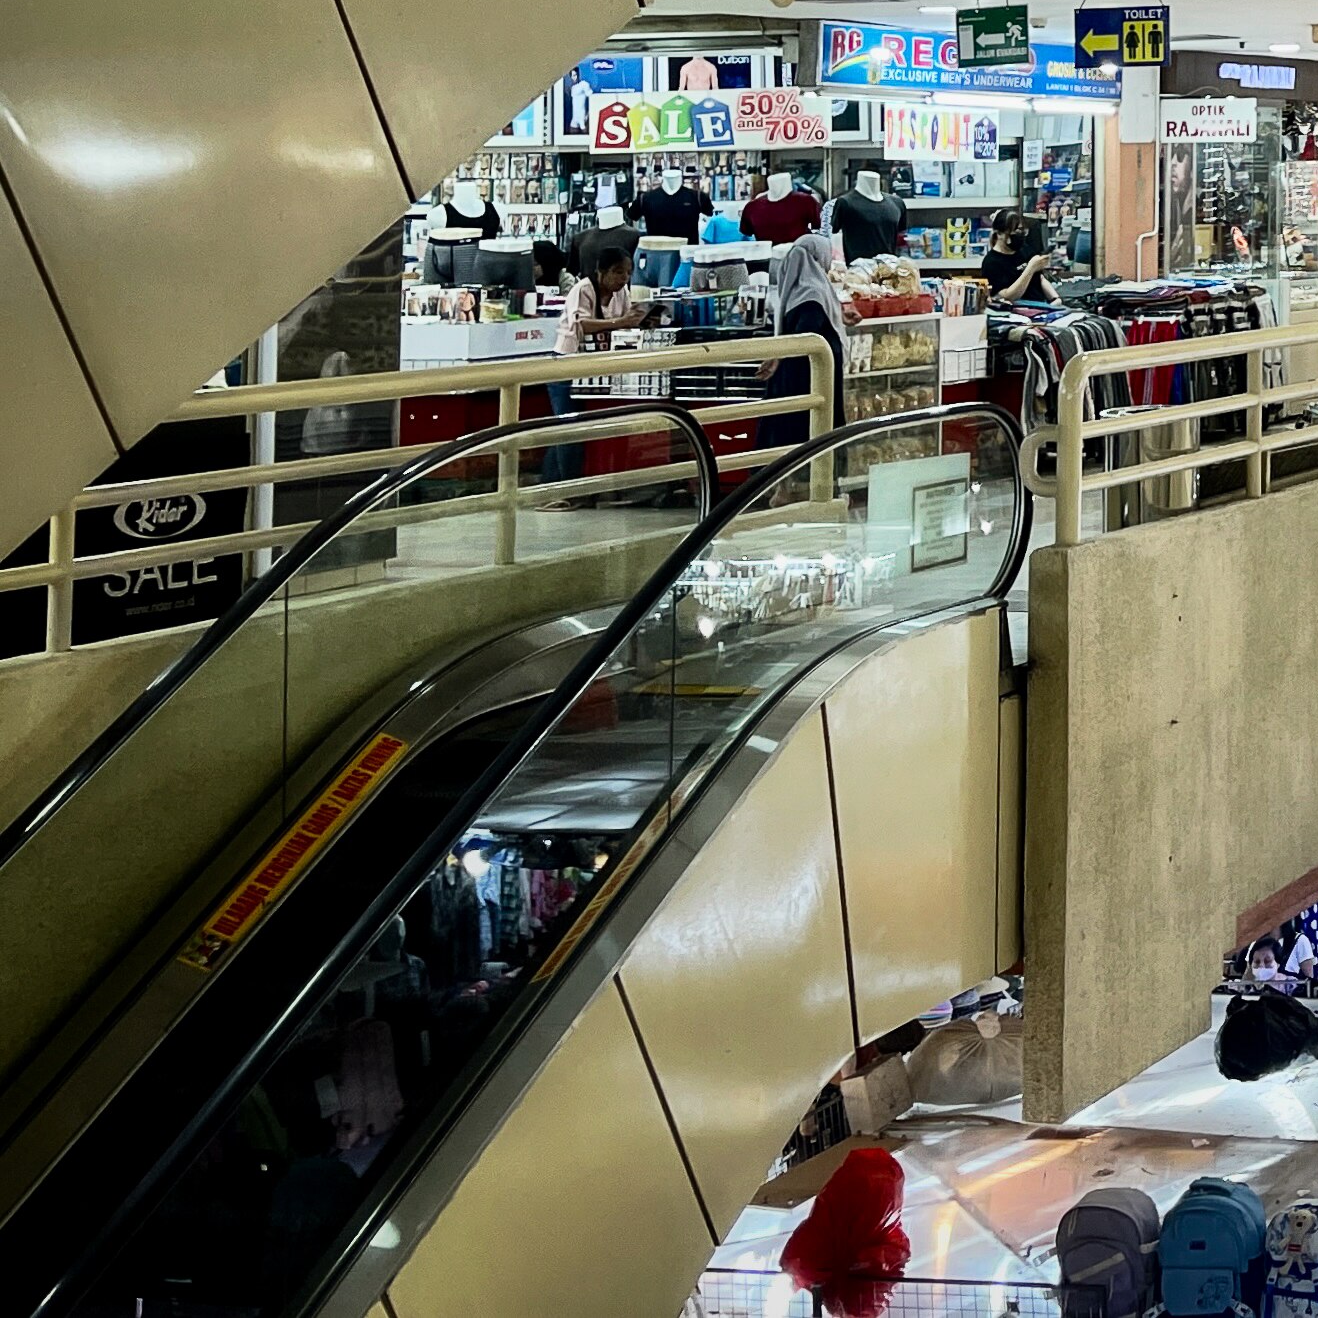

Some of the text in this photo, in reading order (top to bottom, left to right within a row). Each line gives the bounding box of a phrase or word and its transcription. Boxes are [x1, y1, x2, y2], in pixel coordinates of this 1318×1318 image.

[1123, 8, 1164, 19] TOILET
[717, 55, 750, 65] Durban
[881, 66, 1033, 89] EXCLUSIVE MEN'S UNDERWEAR
[599, 93, 800, 145] SALE 50%
[1191, 104, 1225, 116] OPTIK
[737, 118, 825, 142] and 70%
[974, 123, 990, 141] 10%
[103, 556, 218, 597] SALE
[211, 883, 271, 937] DILARANG
